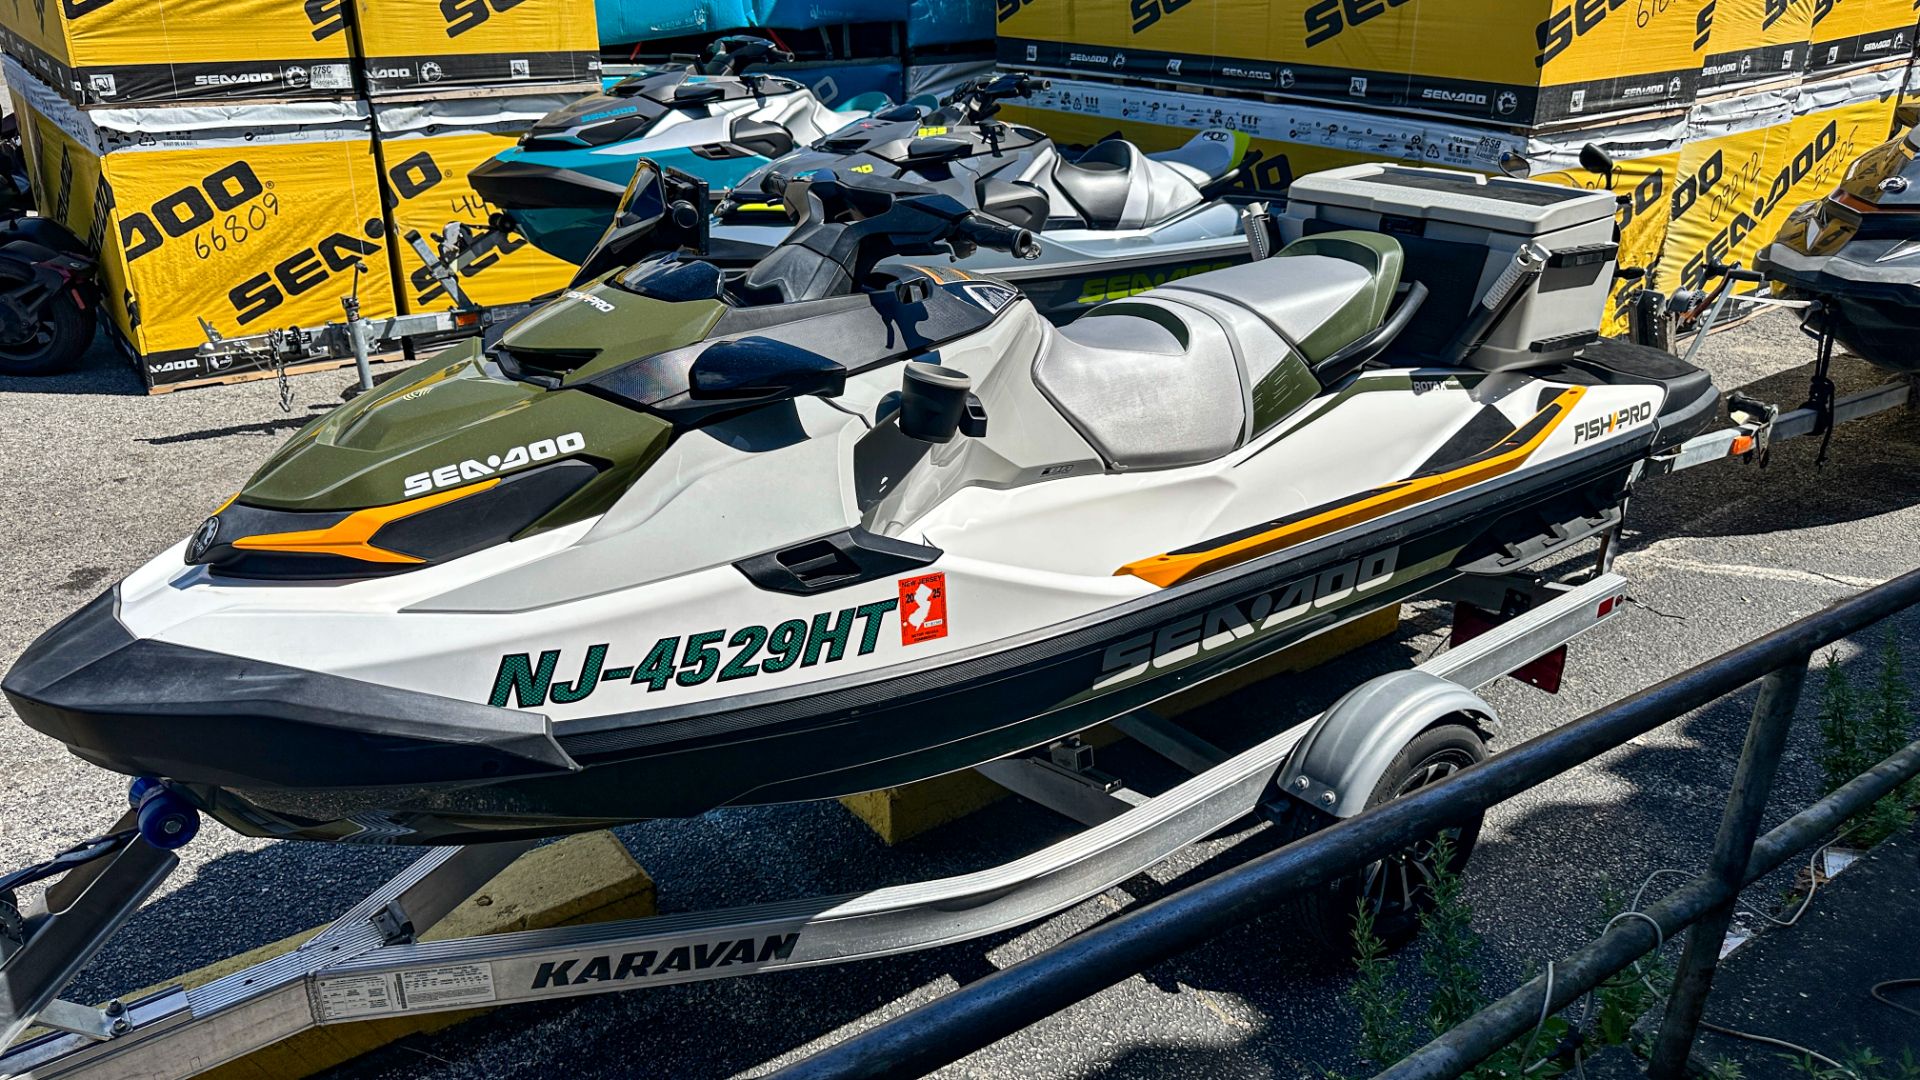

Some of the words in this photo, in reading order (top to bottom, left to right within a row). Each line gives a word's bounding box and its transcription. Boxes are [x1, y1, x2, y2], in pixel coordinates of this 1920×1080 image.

[194, 192, 279, 260] 66809
[487, 598, 900, 709] NJ-4529HT
[530, 932, 801, 989] KARAVAN
